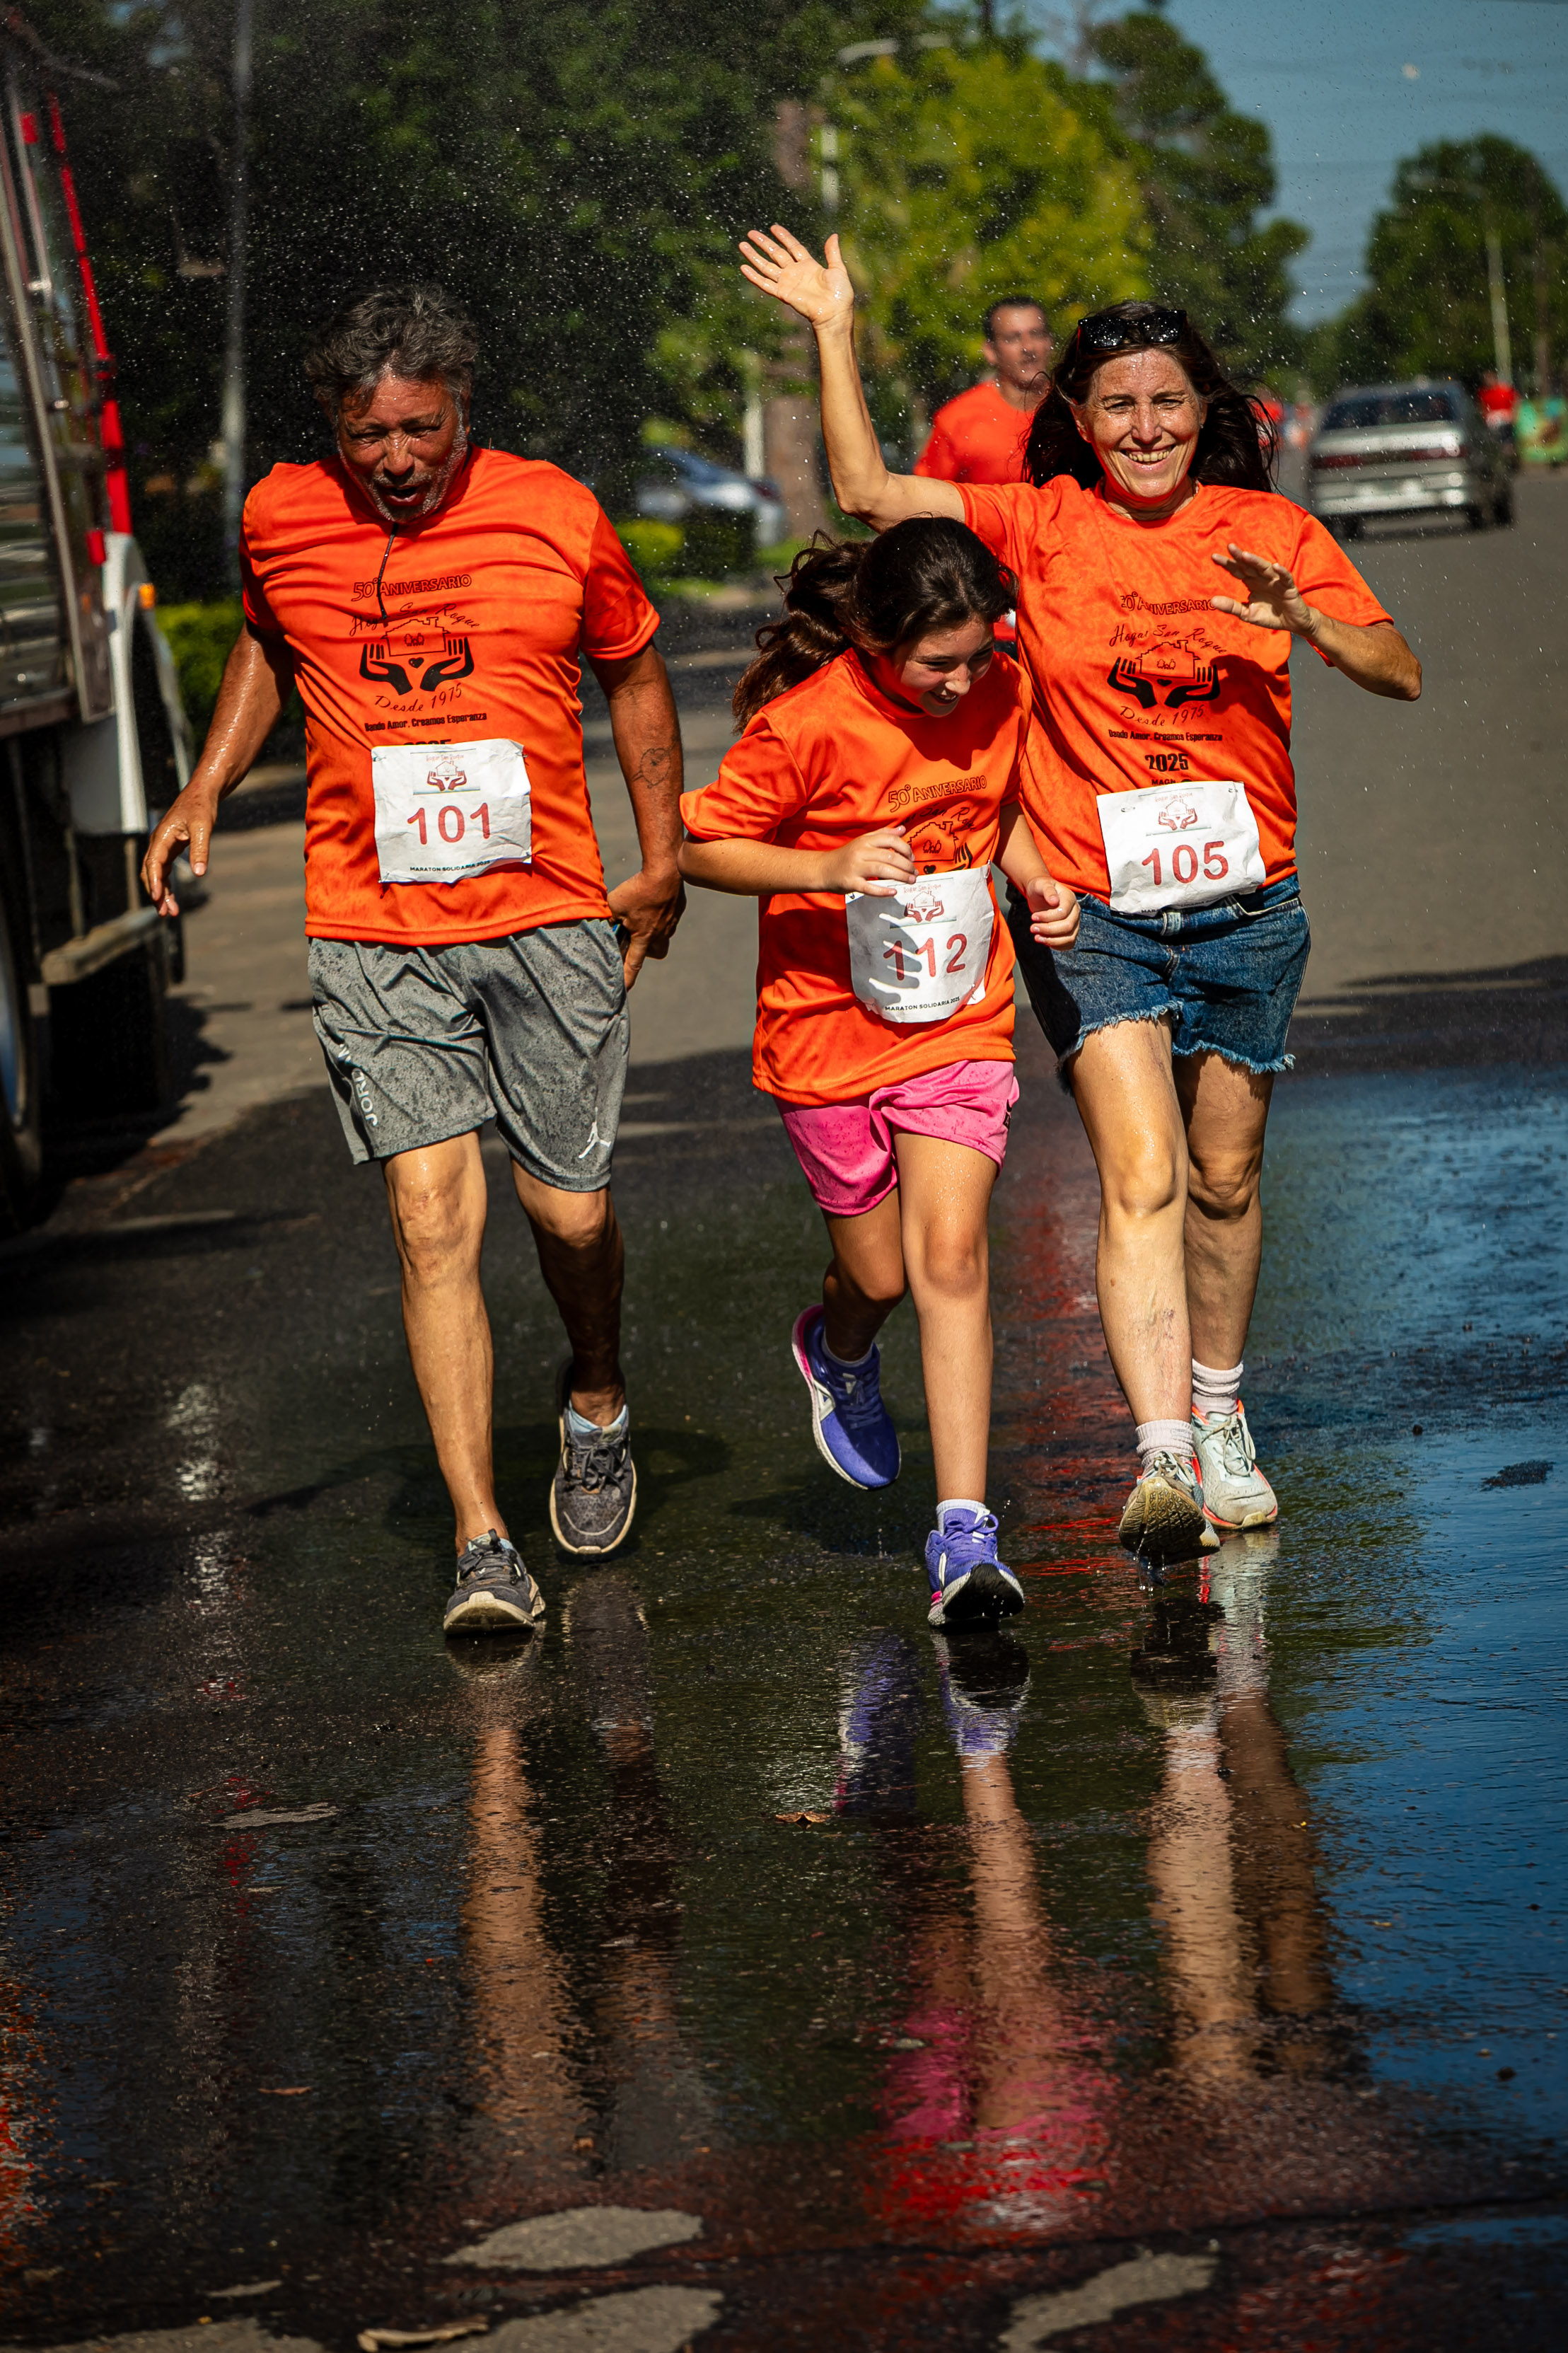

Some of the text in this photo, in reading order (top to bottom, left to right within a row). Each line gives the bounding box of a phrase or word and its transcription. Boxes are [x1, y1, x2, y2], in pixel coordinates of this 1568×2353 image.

[378, 574, 472, 596] ANIVERSARIO
[397, 602, 429, 616] San
[436, 603, 480, 628] Roque
[1109, 624, 1226, 654] Hogar San Roque
[375, 683, 462, 712] Desde 1975
[364, 722, 385, 732] Dando
[412, 716, 445, 727] Creamos
[447, 712, 487, 724] Esperanza
[1120, 704, 1204, 727] Desde 1975
[1108, 729, 1128, 739] Dando
[1154, 732, 1184, 741] Creamos
[1186, 732, 1223, 742] Esperanza
[1145, 753, 1188, 772] 2025
[888, 775, 987, 813] 50° ANIVERSARIO
[407, 802, 491, 845] 101
[442, 863, 475, 872] SOLIDARIA
[1142, 840, 1229, 886] 105
[883, 933, 968, 981] 112
[919, 1000, 949, 1009] SOLIDARIA
